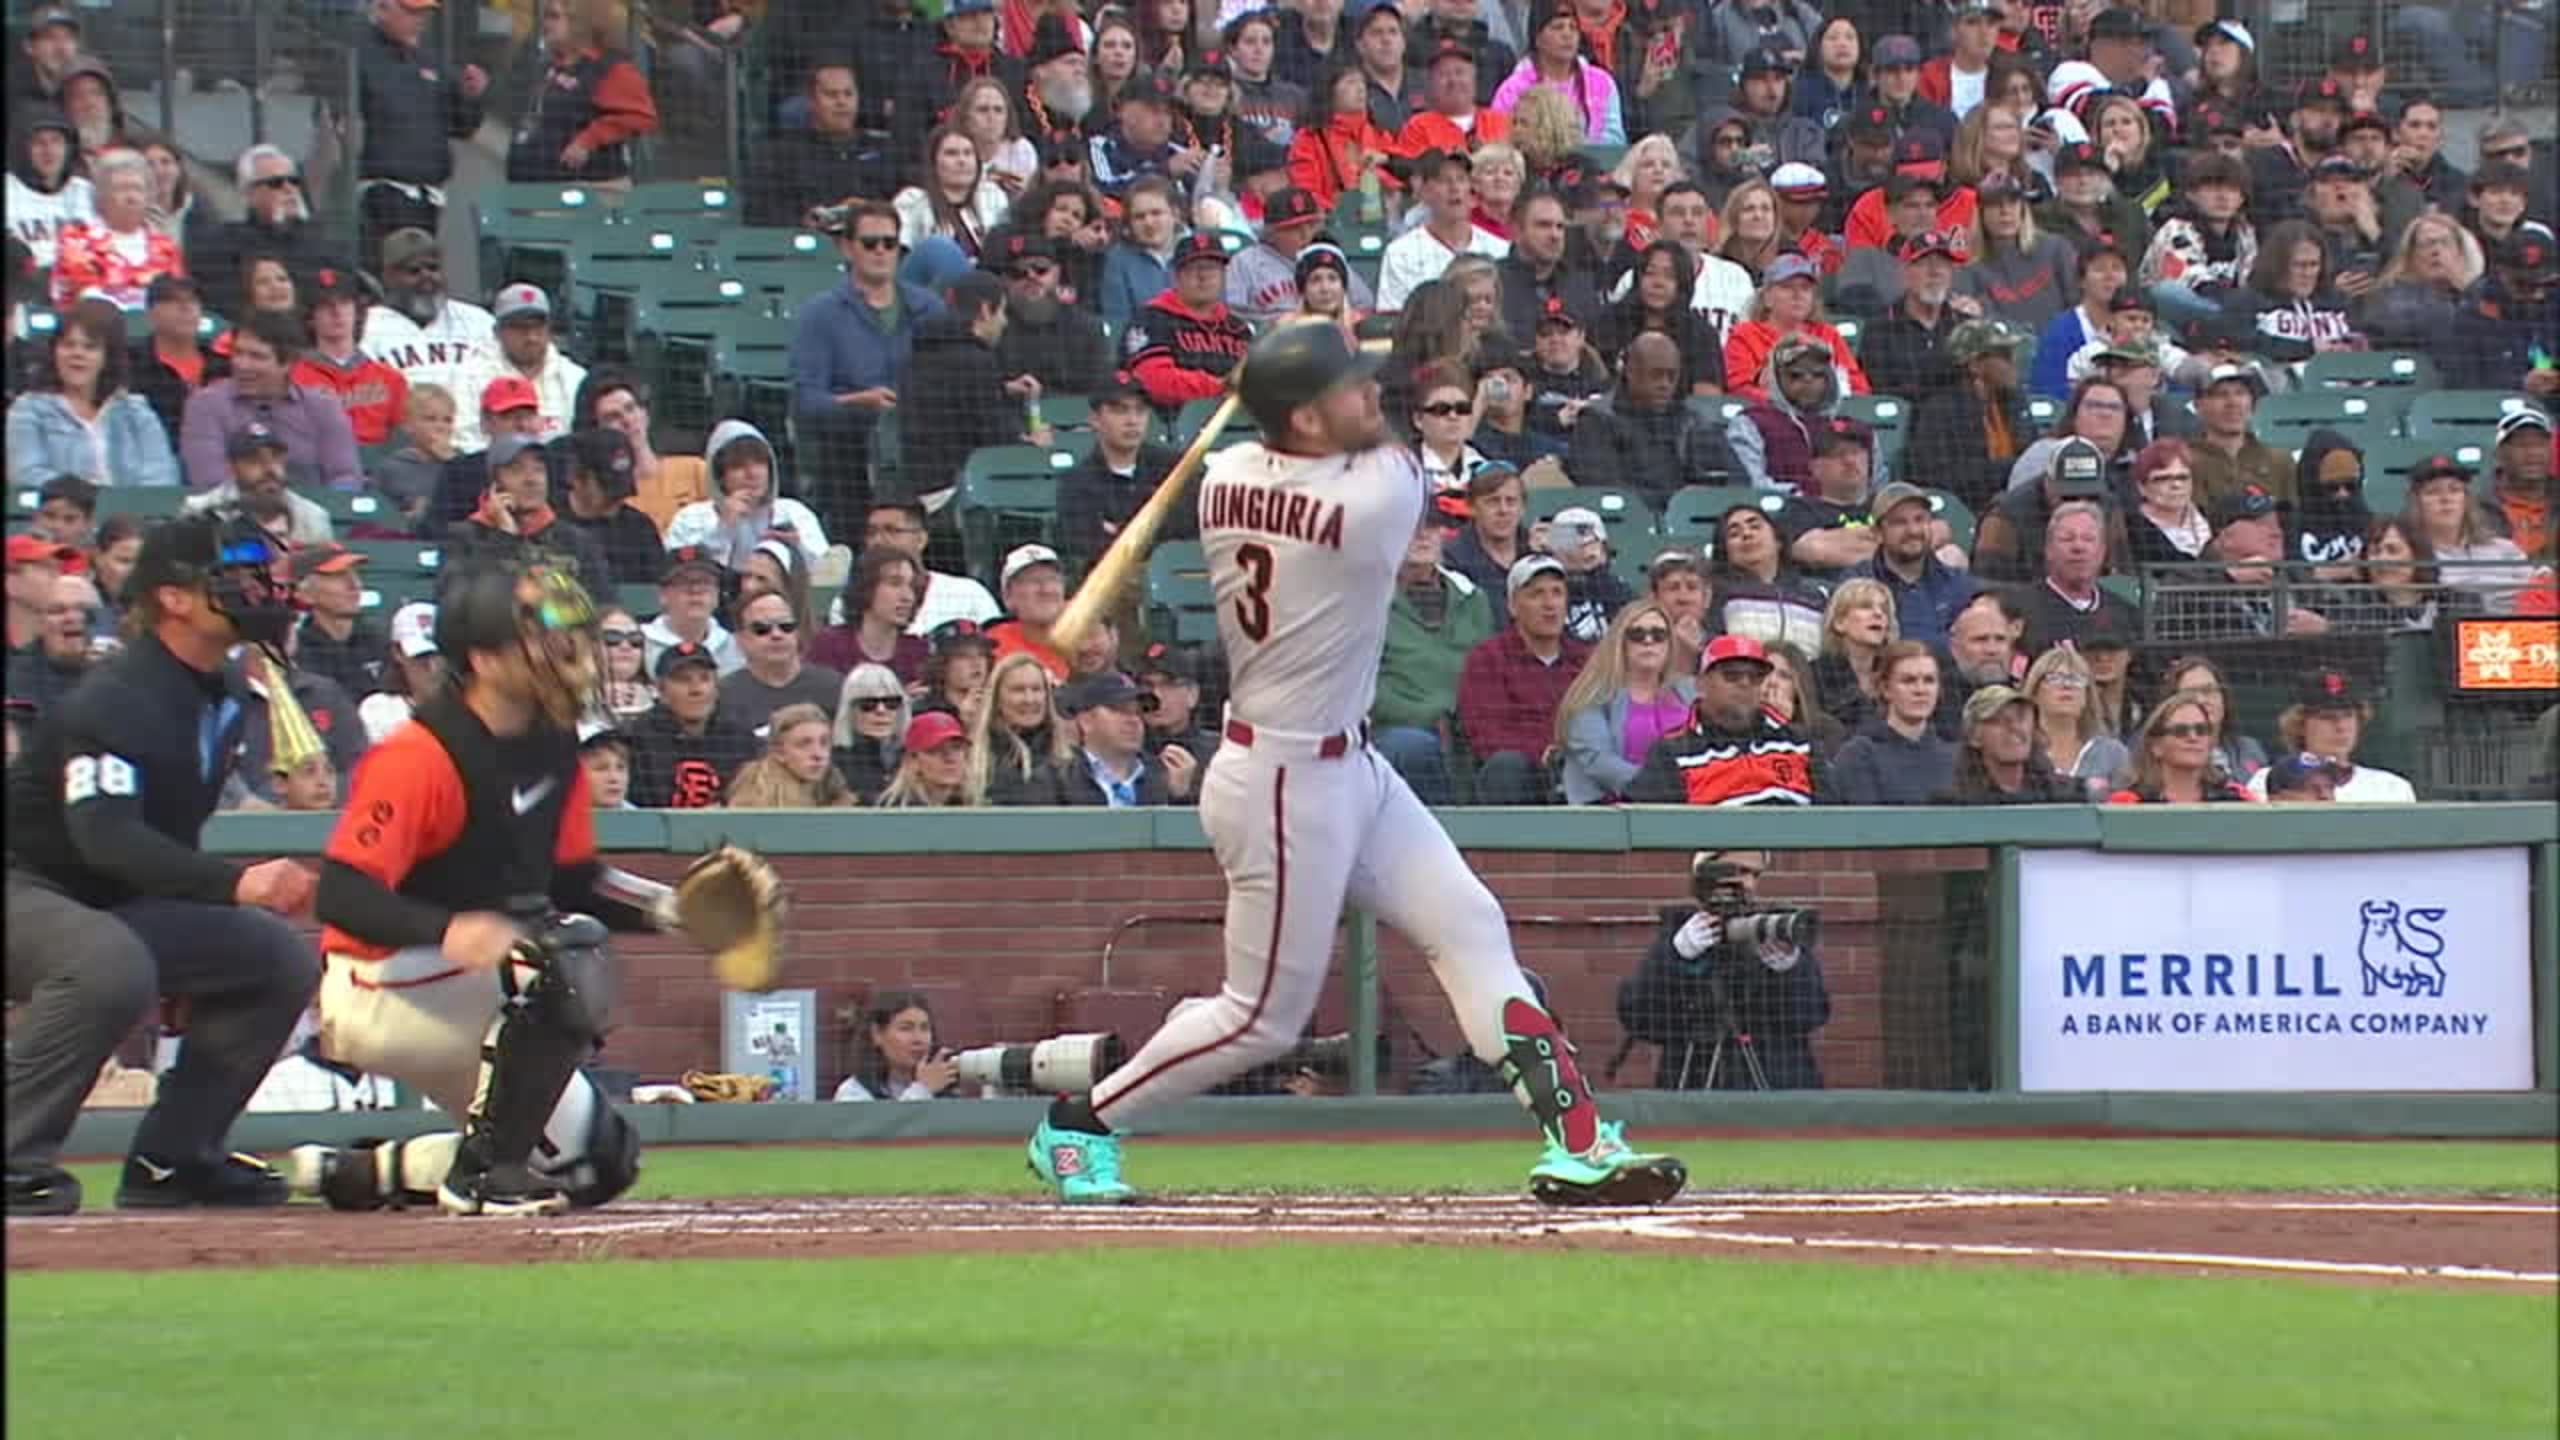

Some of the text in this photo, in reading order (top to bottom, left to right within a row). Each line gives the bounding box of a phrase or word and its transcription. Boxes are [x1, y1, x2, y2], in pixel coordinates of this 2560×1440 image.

[1203, 483, 1345, 550] LONGORIA
[1235, 542, 1273, 643] 3
[64, 754, 137, 804] 28
[2062, 953, 2341, 997] MERRILL
[2061, 1012, 2489, 1034] A BANK OF AMERICA COMPANY
